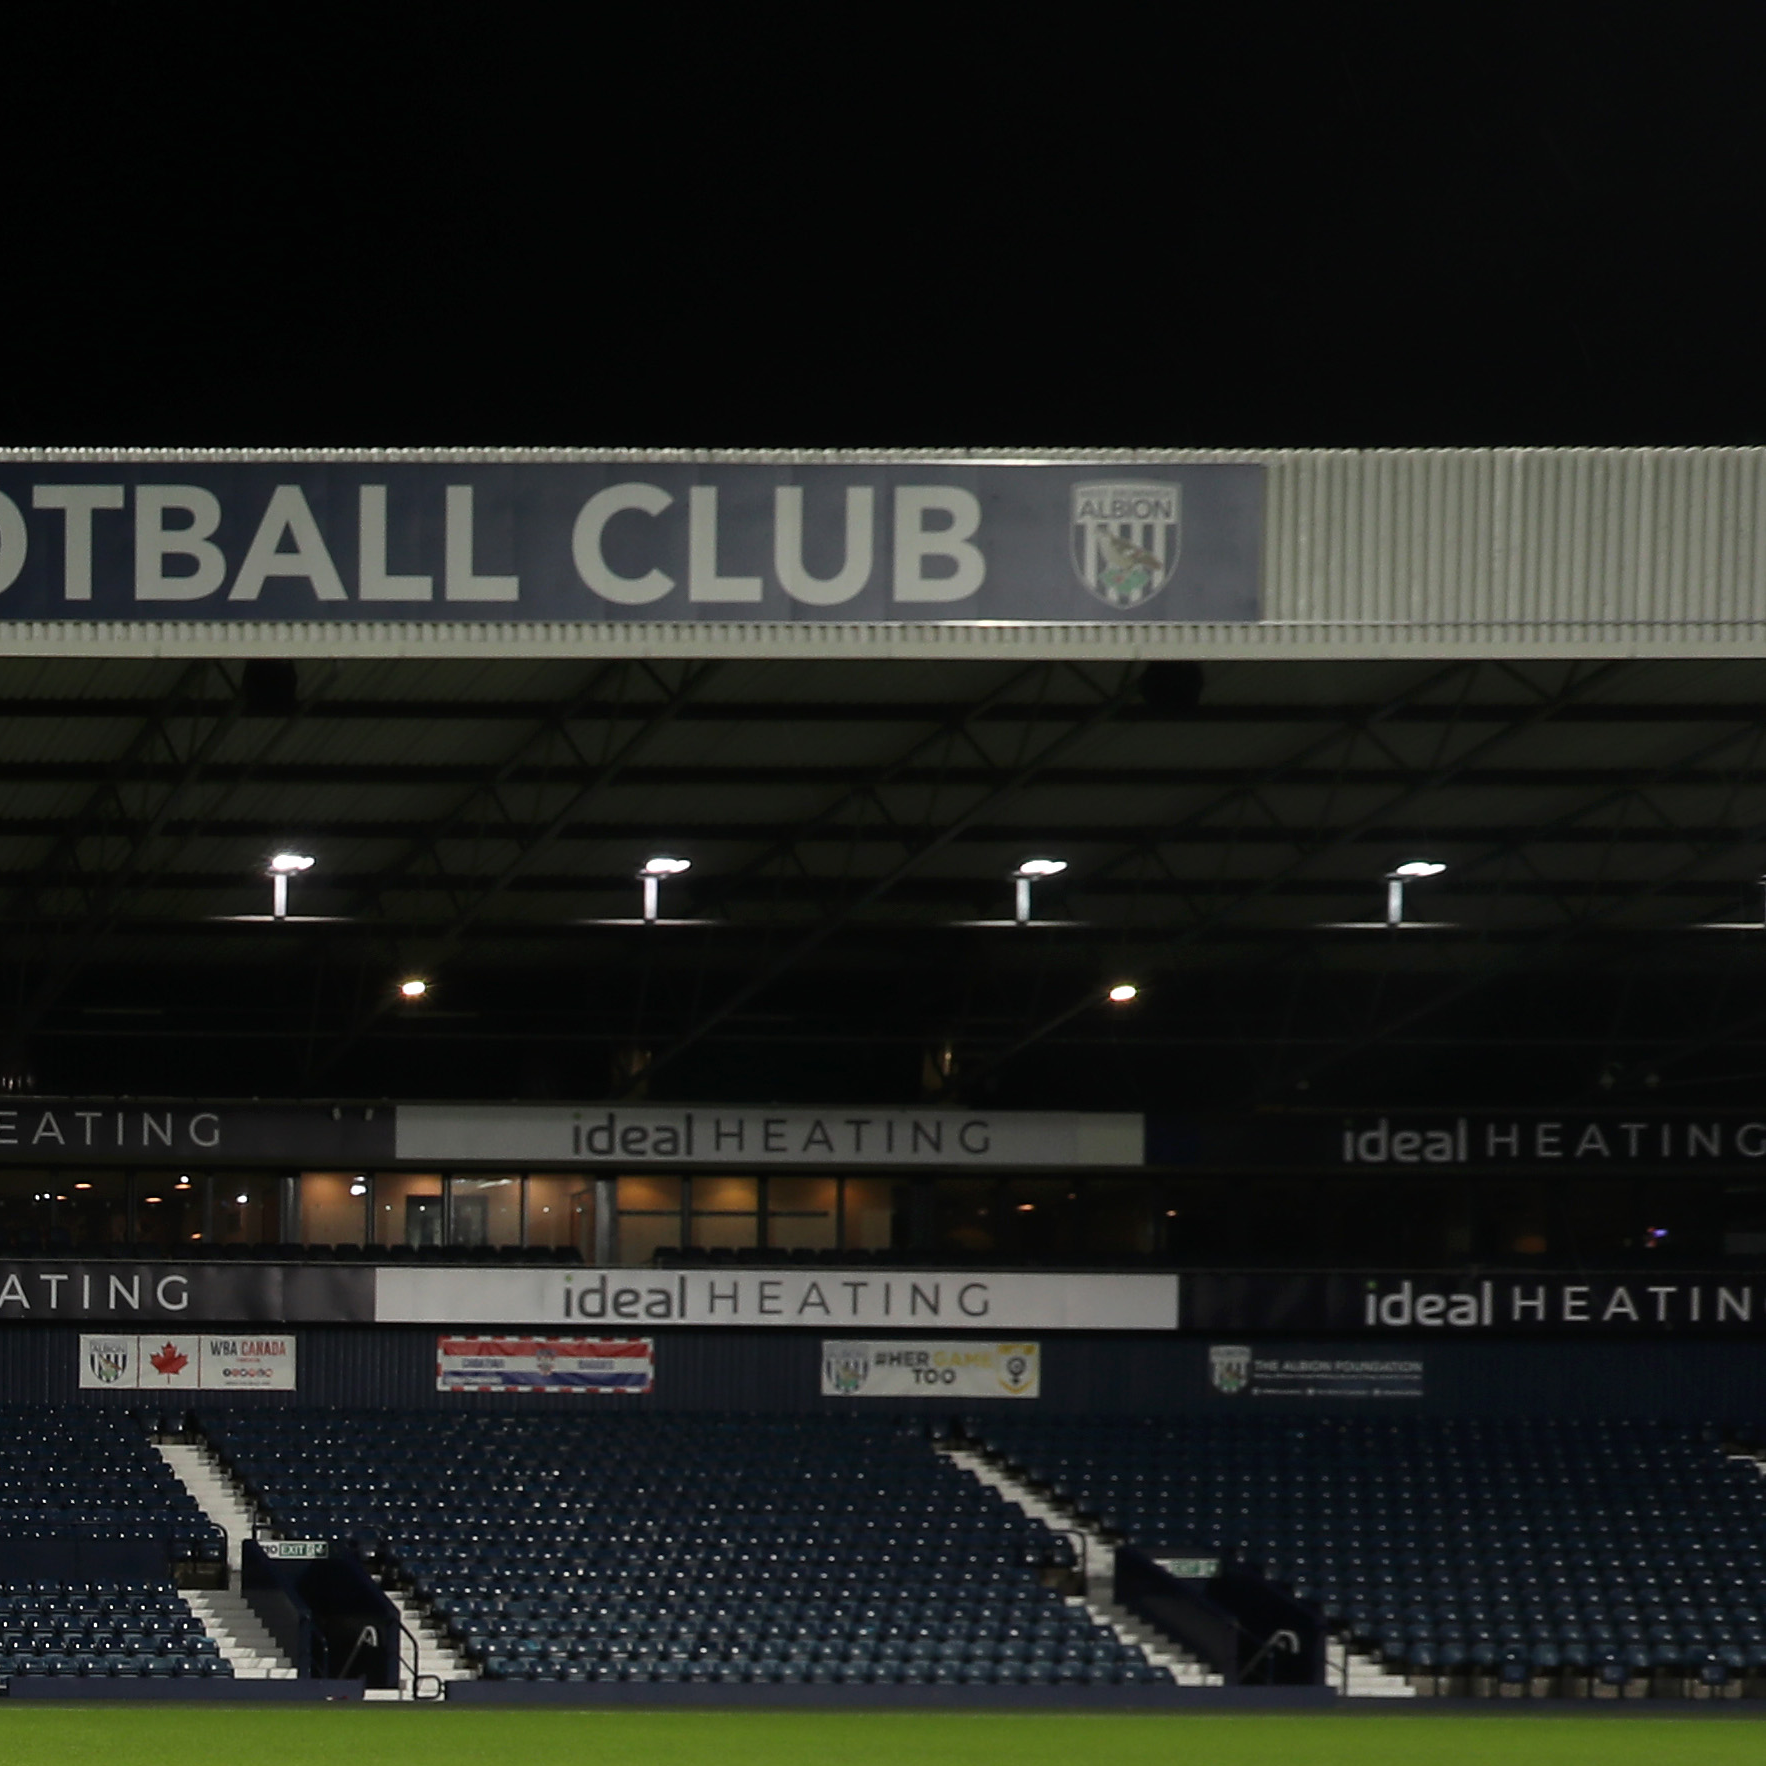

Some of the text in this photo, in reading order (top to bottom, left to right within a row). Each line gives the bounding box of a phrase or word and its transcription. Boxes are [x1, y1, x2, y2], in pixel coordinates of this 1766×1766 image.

[1081, 500, 1171, 519] ALBION
[569, 482, 986, 605] CLUB
[573, 1112, 990, 1157] ideal HEATING
[1344, 1119, 1766, 1162] ideal HEATING
[564, 1274, 990, 1320] ideal HEATING
[1366, 1282, 1766, 1326] ideal HEATIN
[211, 1341, 286, 1356] WBA CANADA
[875, 1352, 929, 1366] #HER
[933, 1352, 992, 1367] GAME
[913, 1370, 955, 1383] TOO
[281, 1546, 305, 1555] EXIT
